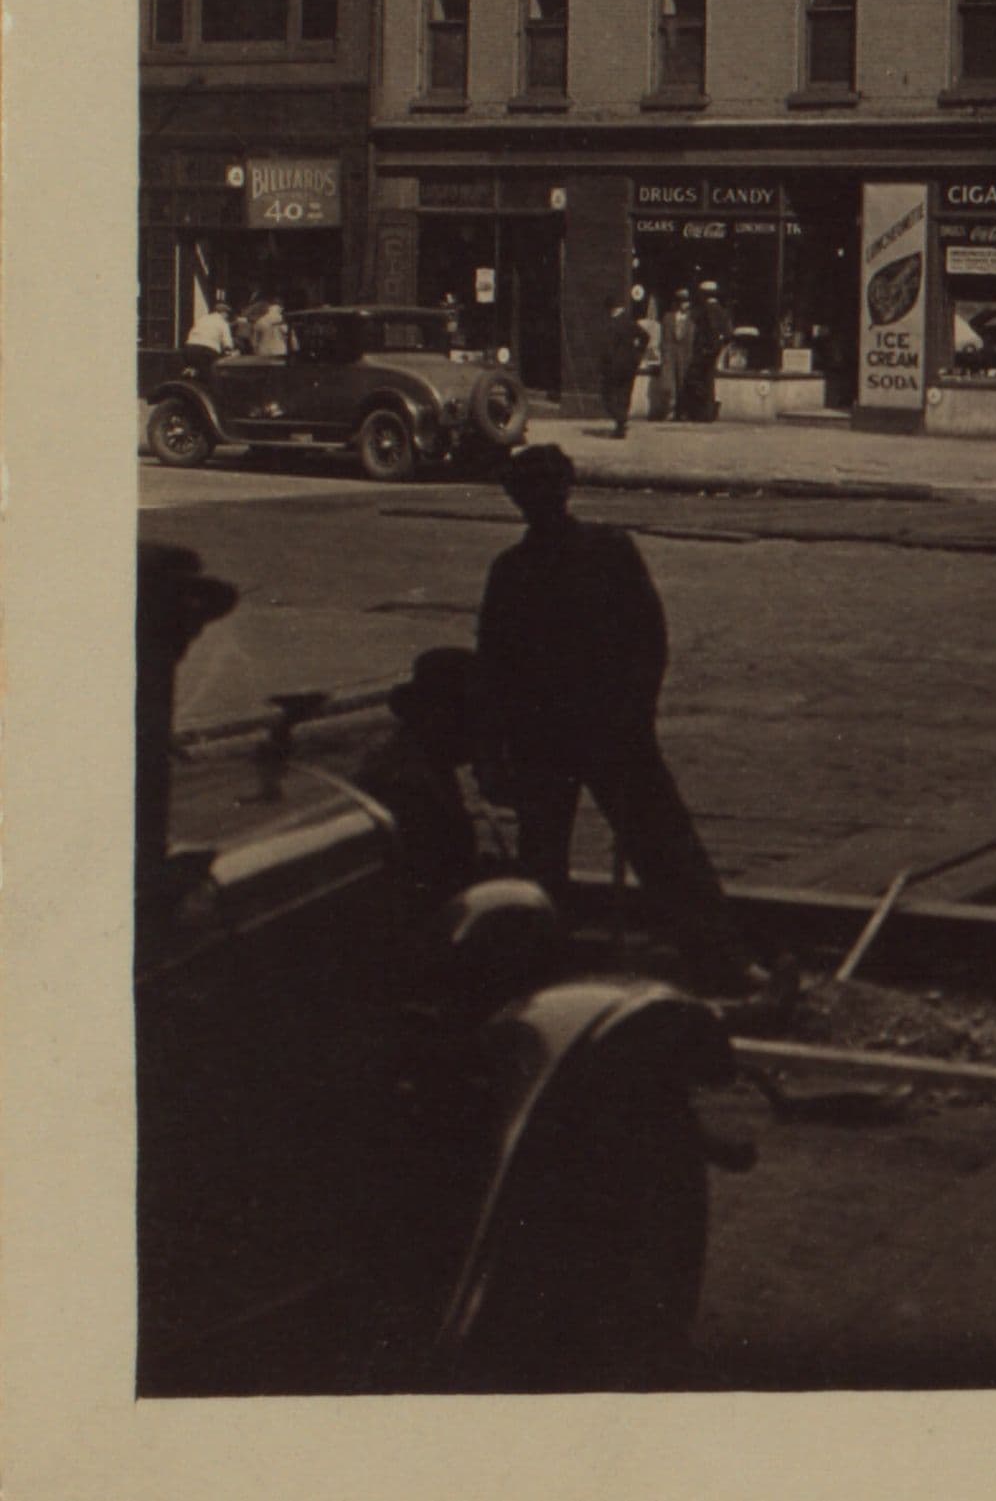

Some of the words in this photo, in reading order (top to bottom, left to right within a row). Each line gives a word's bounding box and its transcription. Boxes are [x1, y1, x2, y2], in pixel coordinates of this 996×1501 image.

[252, 166, 337, 199] BILLIARDS
[639, 187, 698, 203] DRUGS
[712, 187, 774, 204] CANDY
[264, 200, 303, 223] 40
[875, 332, 911, 349] ICE
[867, 350, 919, 368] CREAM
[867, 374, 919, 390] SODA
